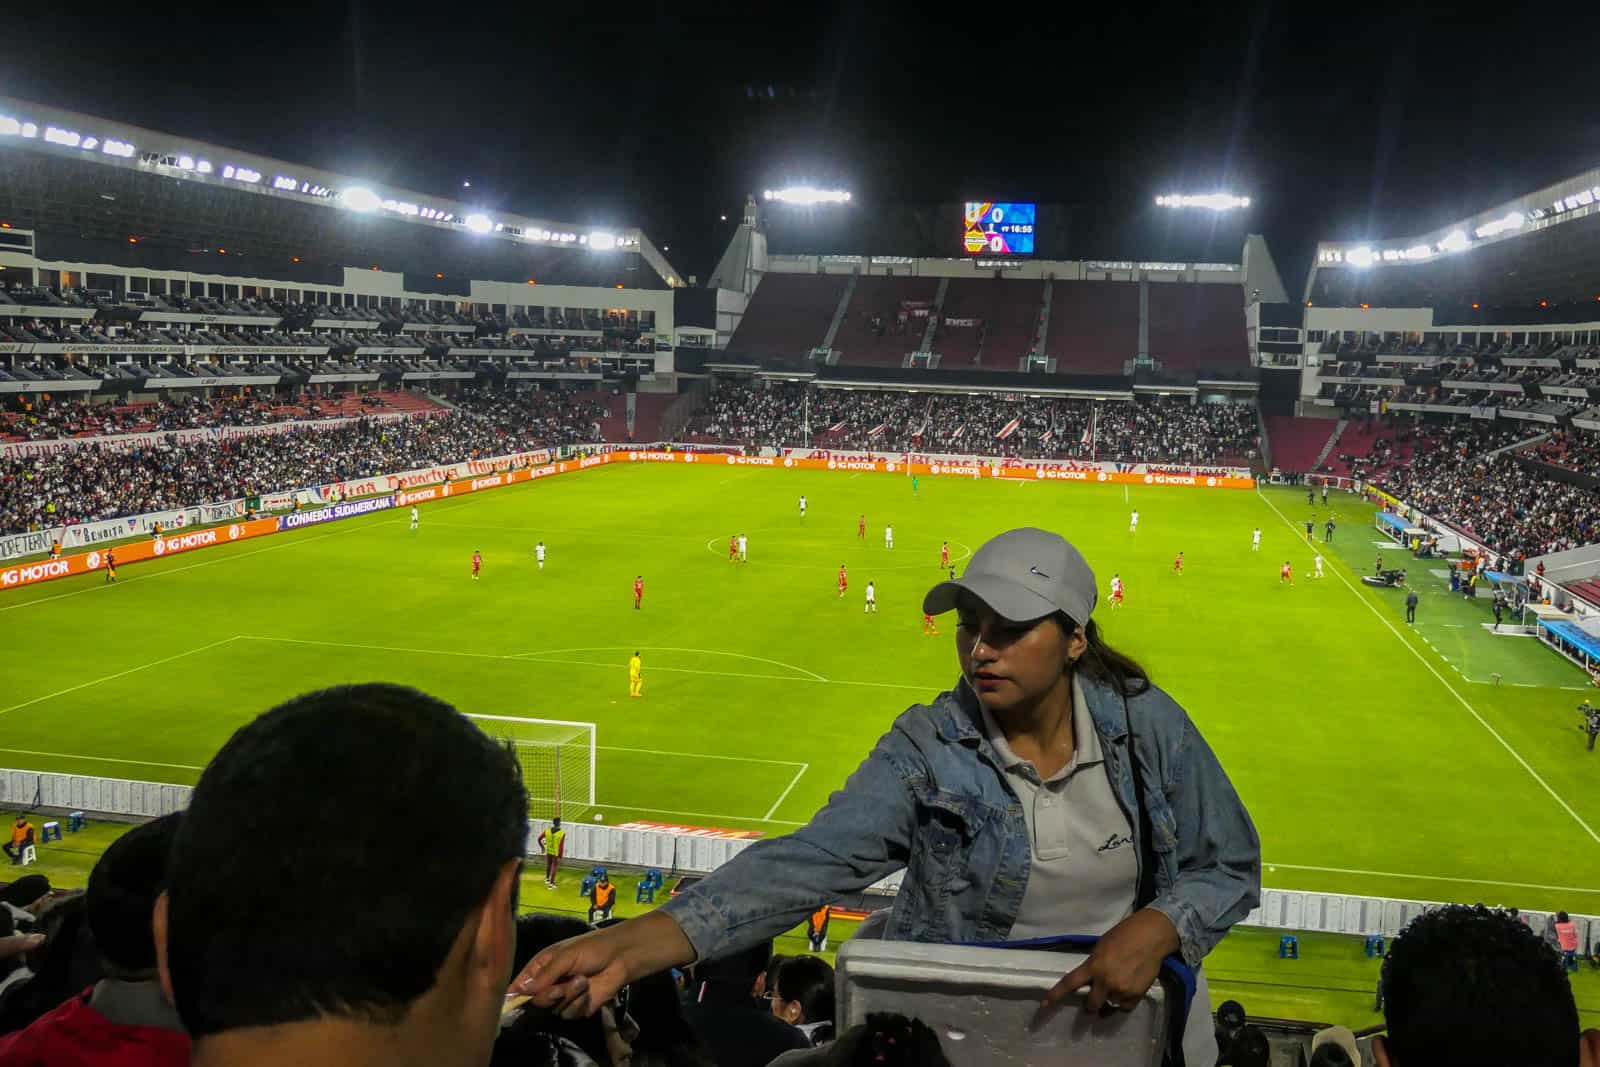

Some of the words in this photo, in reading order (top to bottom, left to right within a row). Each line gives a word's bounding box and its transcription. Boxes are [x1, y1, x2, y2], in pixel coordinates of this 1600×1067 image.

[991, 208, 1004, 224] 0
[991, 237, 1003, 252] 0
[286, 506, 334, 526] CONMEBOL
[335, 497, 390, 517] SUDAMERICANA
[180, 530, 217, 548] MOTOR
[20, 560, 70, 582] MOTOR
